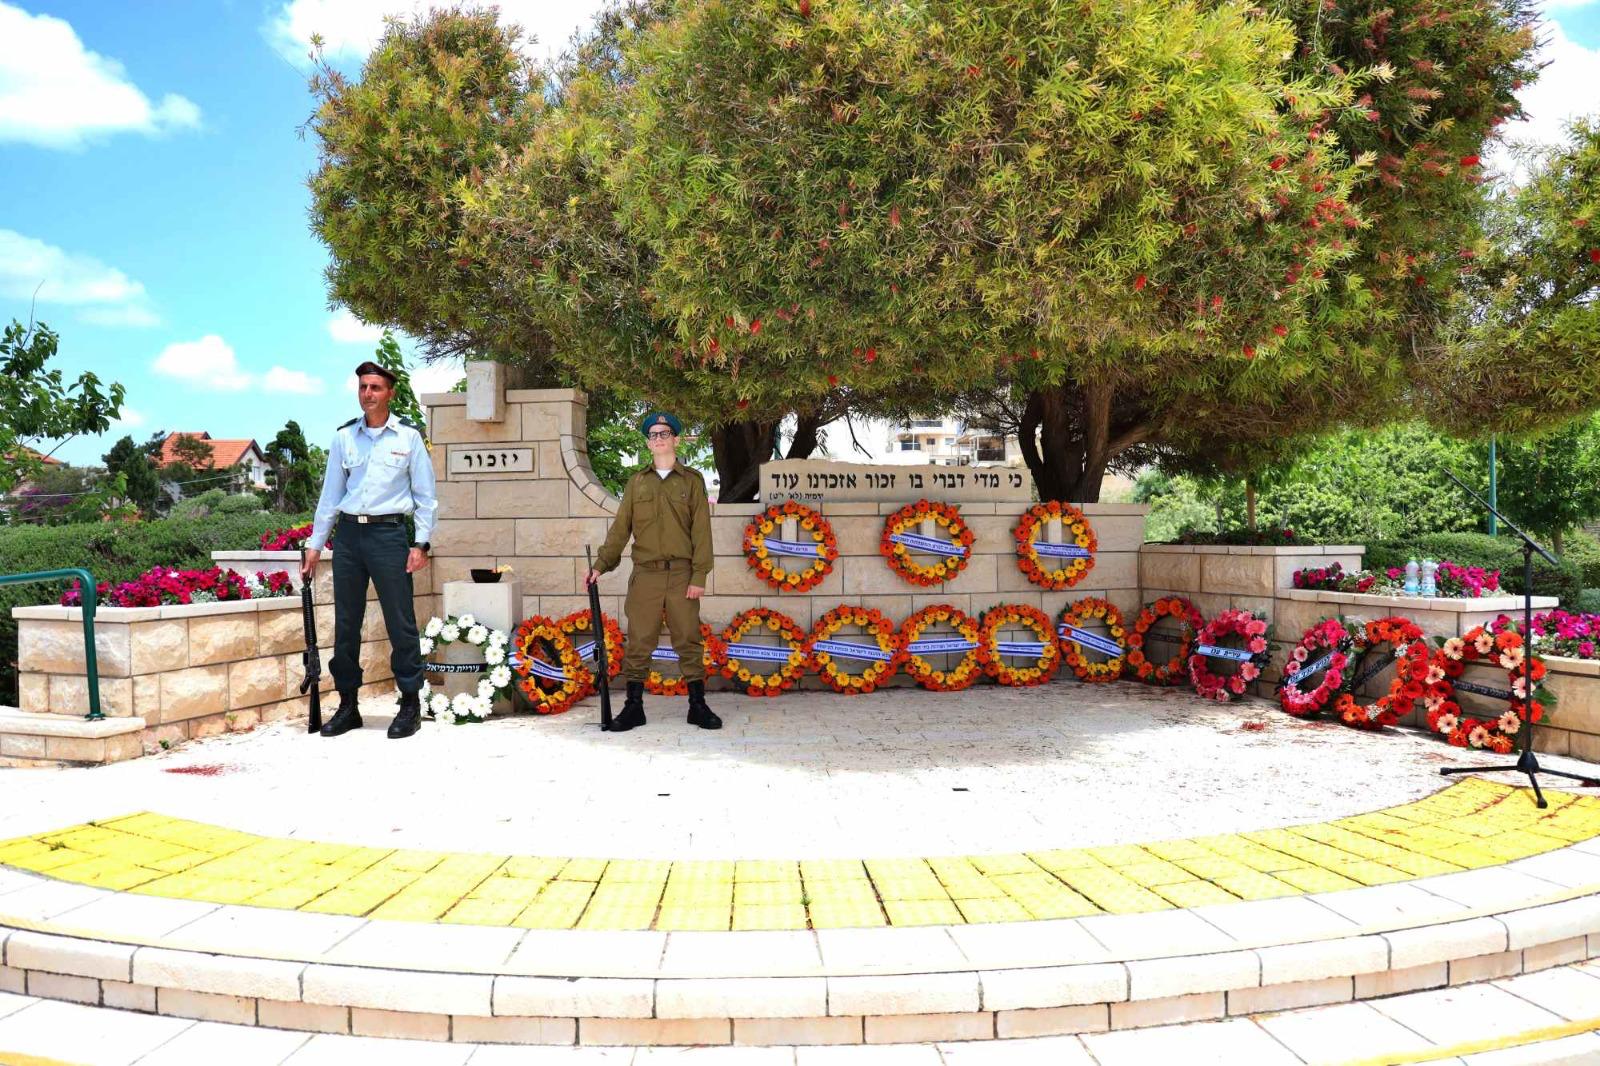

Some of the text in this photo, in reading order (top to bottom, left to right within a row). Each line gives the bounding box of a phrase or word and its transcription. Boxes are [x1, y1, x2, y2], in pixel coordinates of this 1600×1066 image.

[464, 453, 519, 468] יזכור
[771, 473, 1023, 490] כי מדי דברי בו זכור אזכרנו עוד
[426, 662, 480, 673] עיריית כרמיאל
